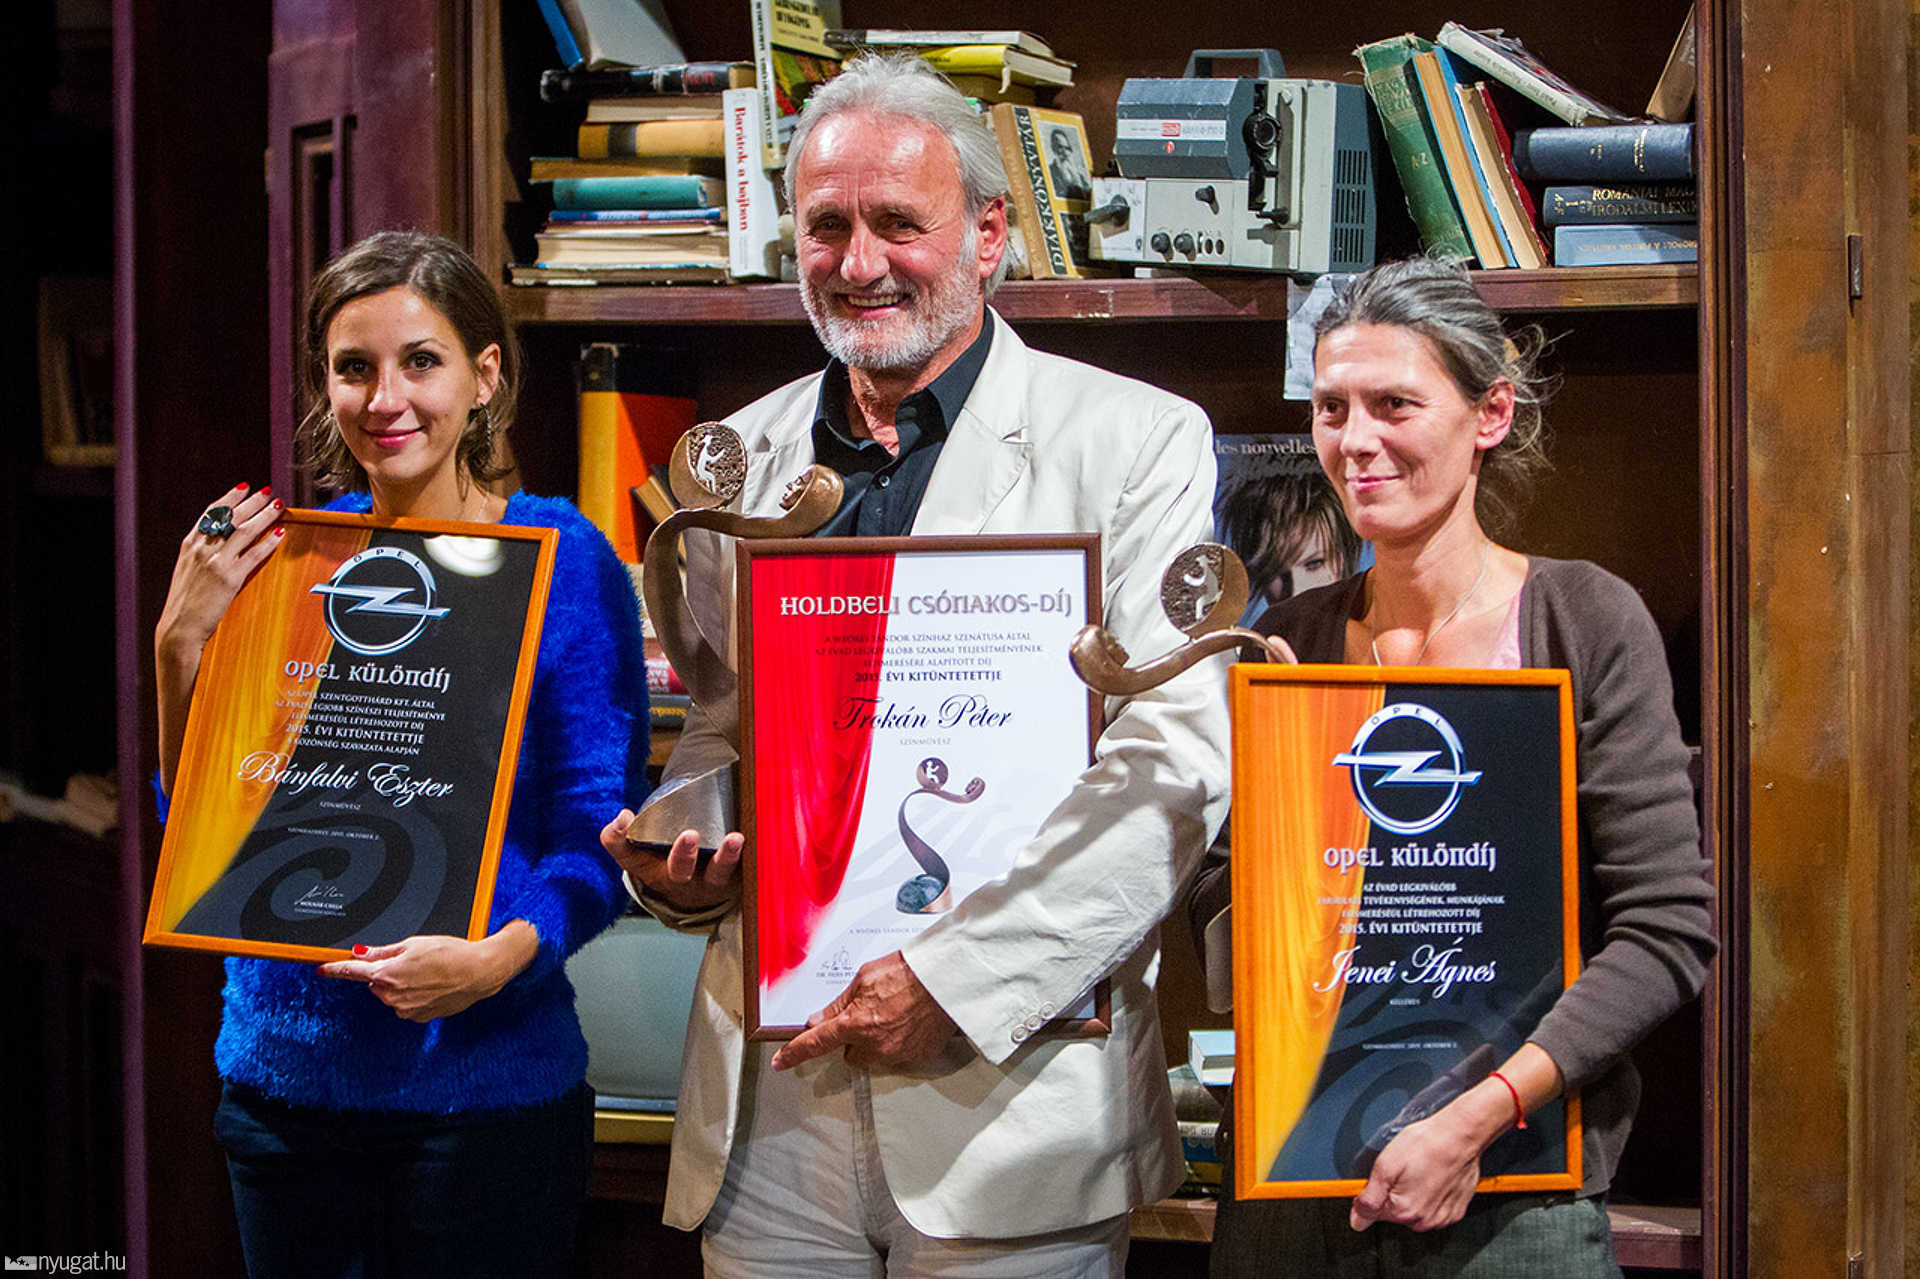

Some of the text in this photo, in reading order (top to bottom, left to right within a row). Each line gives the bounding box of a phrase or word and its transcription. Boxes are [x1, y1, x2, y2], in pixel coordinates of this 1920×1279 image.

[734, 107, 749, 163] Barátok
[1018, 114, 1066, 268] DIÁKKÖNYVTÁR
[736, 181, 750, 231] bajban
[353, 547, 421, 569] OPEL
[780, 595, 900, 616] HOLDBELI
[886, 670, 905, 682] ÉVI
[908, 670, 1002, 682] KITÜNTETETTJE
[832, 694, 1012, 730] Trokán Péter
[1371, 707, 1440, 727] OPEL
[314, 724, 334, 737] ÉVI
[237, 750, 454, 808] Bánfalvi Eszter
[1369, 920, 1389, 934] ÉVI
[1313, 936, 1497, 999] Jenei Ágnes
